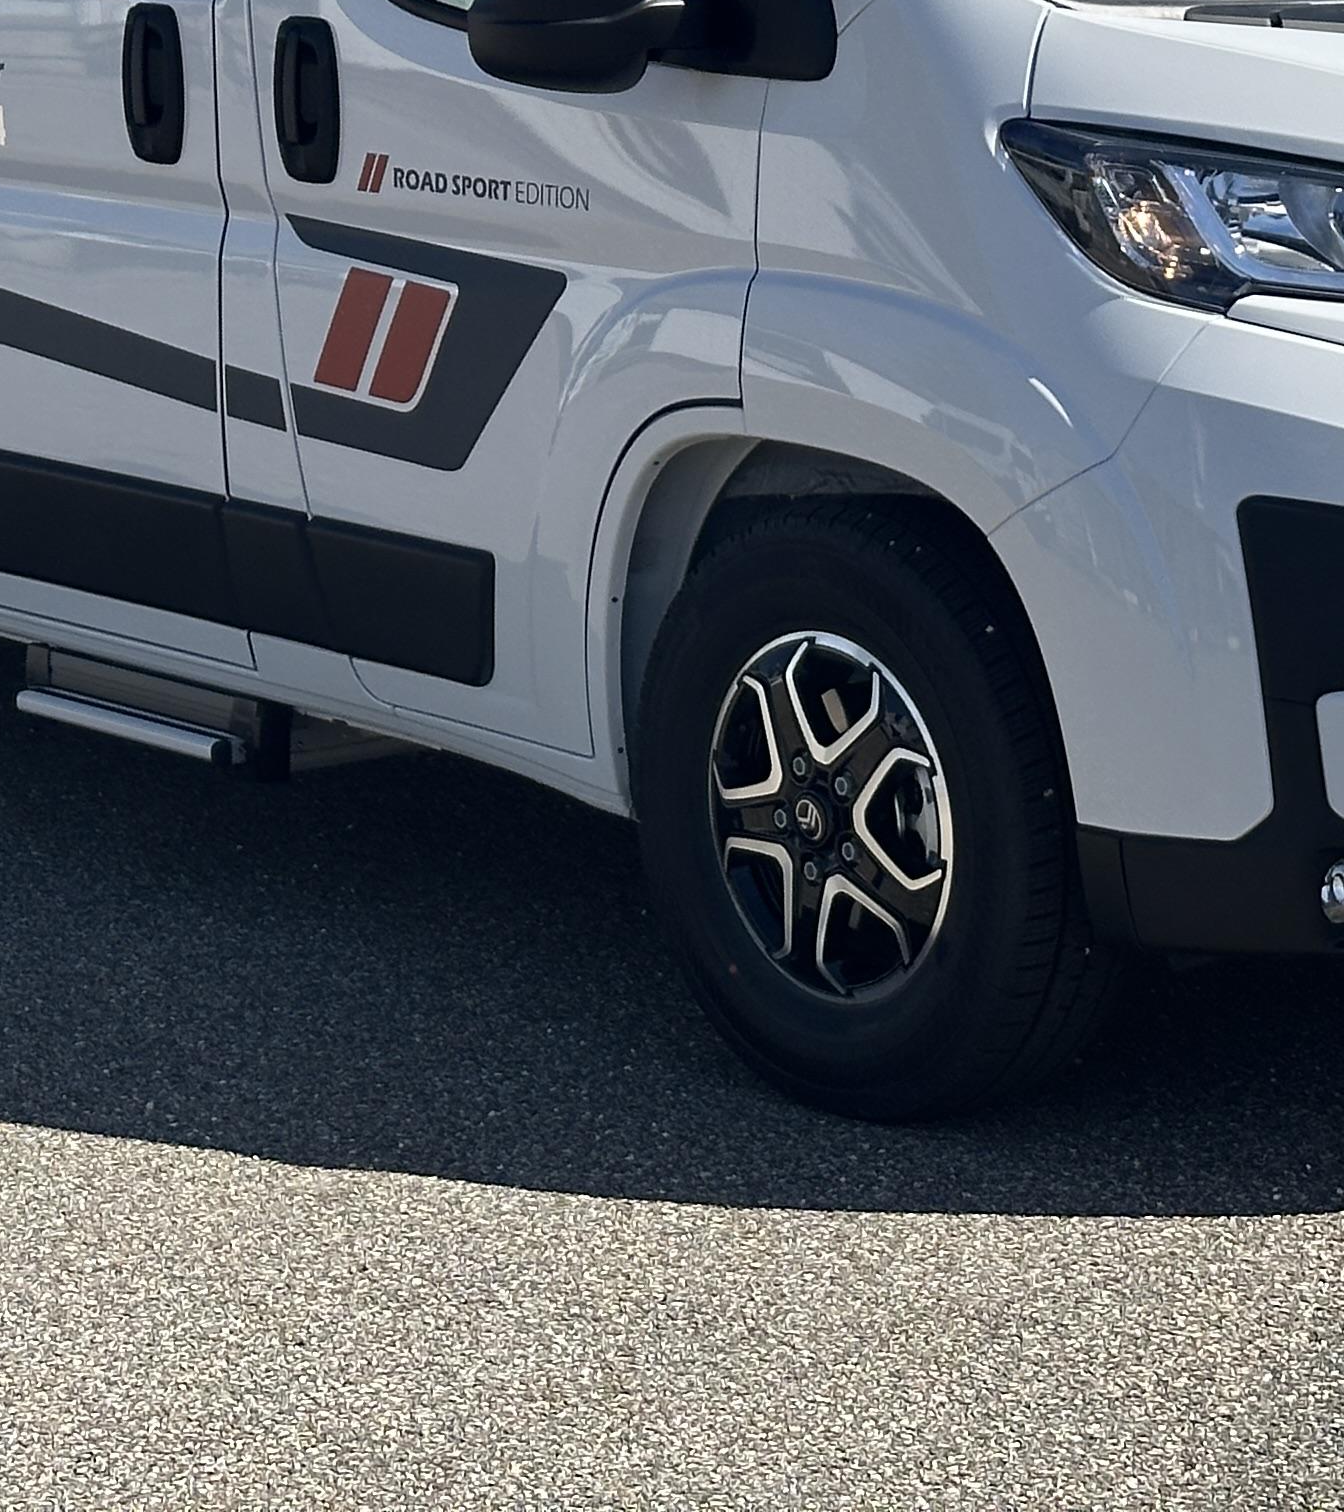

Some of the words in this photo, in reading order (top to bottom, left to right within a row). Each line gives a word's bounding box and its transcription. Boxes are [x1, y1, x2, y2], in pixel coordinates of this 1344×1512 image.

[393, 167, 447, 194] ROAD
[452, 174, 511, 201] SPORT
[515, 181, 589, 211] EDITION
